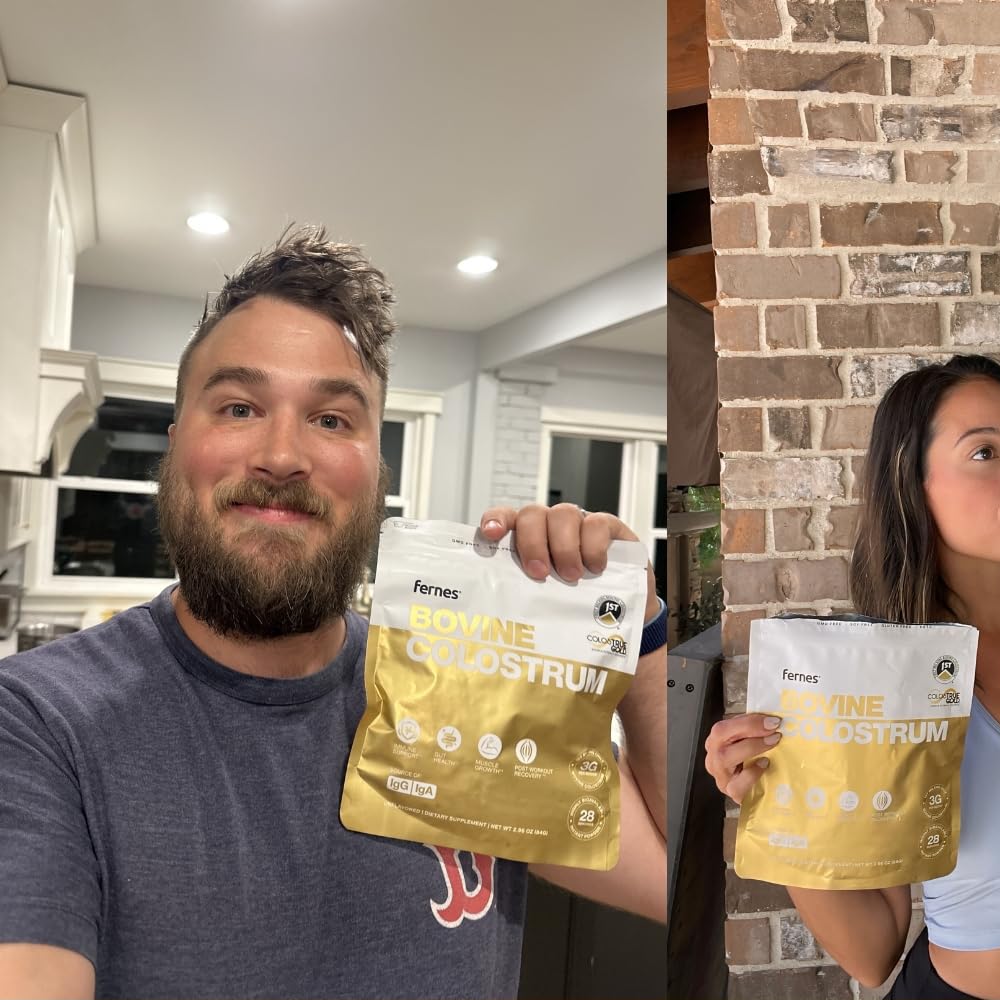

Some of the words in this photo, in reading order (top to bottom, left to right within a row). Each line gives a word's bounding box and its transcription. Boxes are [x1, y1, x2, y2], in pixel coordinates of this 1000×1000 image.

[413, 580, 459, 600] fernes
[605, 602, 619, 612] 1ST
[409, 603, 536, 650] BOVINE
[406, 635, 609, 696] COLOSTRUM
[942, 662, 952, 670] 1ST
[782, 669, 819, 684] fernes
[780, 688, 885, 718] BOVINE
[781, 717, 948, 745] COLOSTRUM
[476, 760, 499, 768] MUSCLE
[580, 761, 598, 772] 3G
[390, 779, 409, 792] IgG
[415, 784, 433, 796] IgA
[929, 794, 942, 806] 3G
[424, 810, 448, 820] DIETARY
[450, 816, 487, 827] SUPPLEMENT
[580, 810, 595, 822] 28
[927, 834, 940, 844] 28
